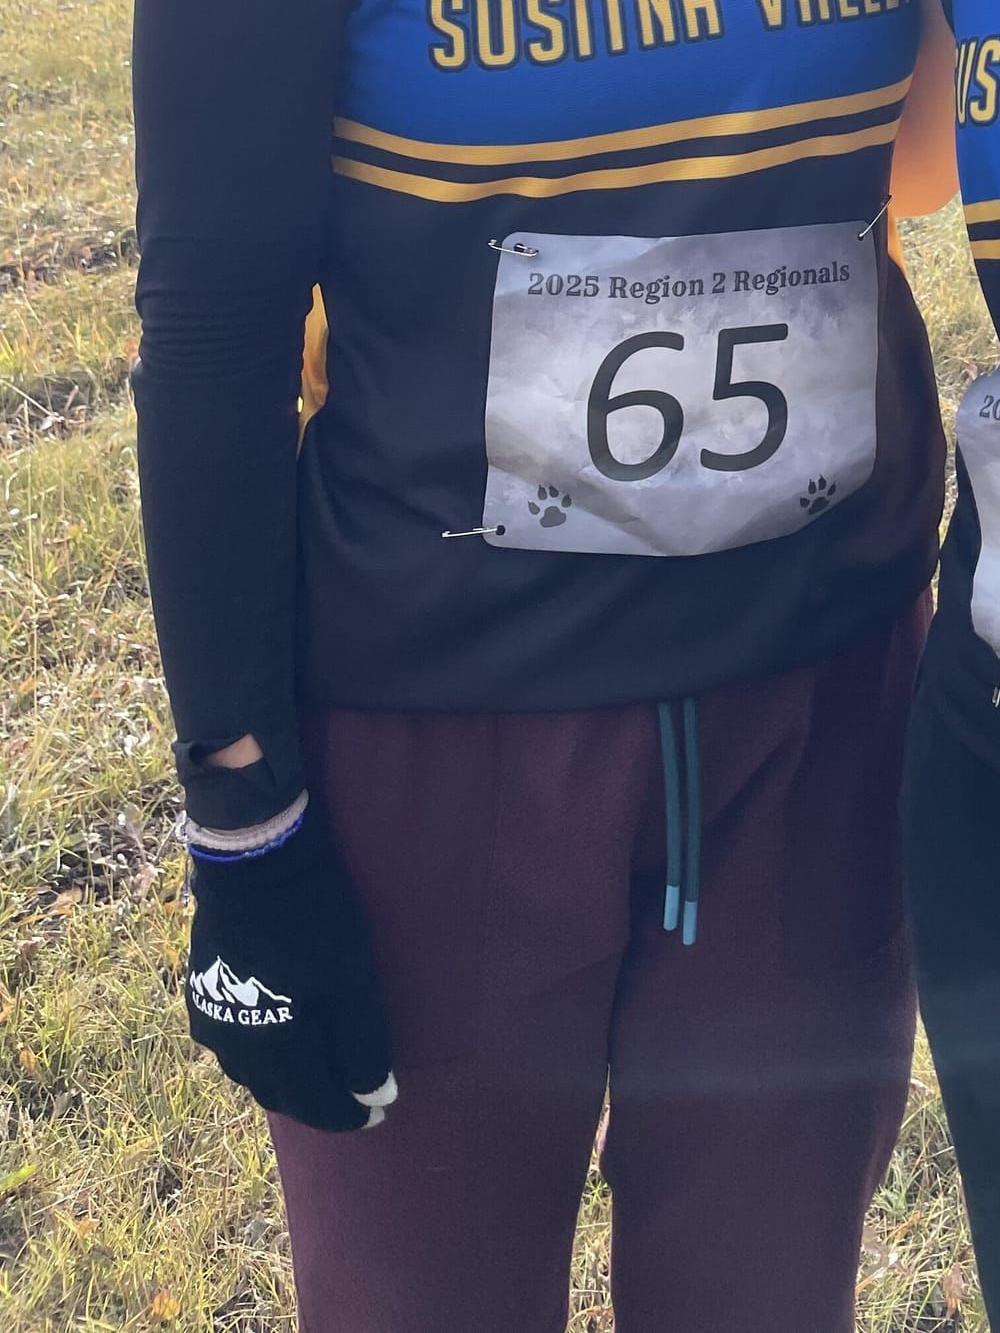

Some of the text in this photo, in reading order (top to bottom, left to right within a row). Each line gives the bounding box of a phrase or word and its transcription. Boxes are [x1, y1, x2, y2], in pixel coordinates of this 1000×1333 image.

[527, 262, 850, 305] 2025 Region 2 Regionals
[587, 323, 789, 482] 65
[192, 991, 293, 1025] LASKA GEAR
